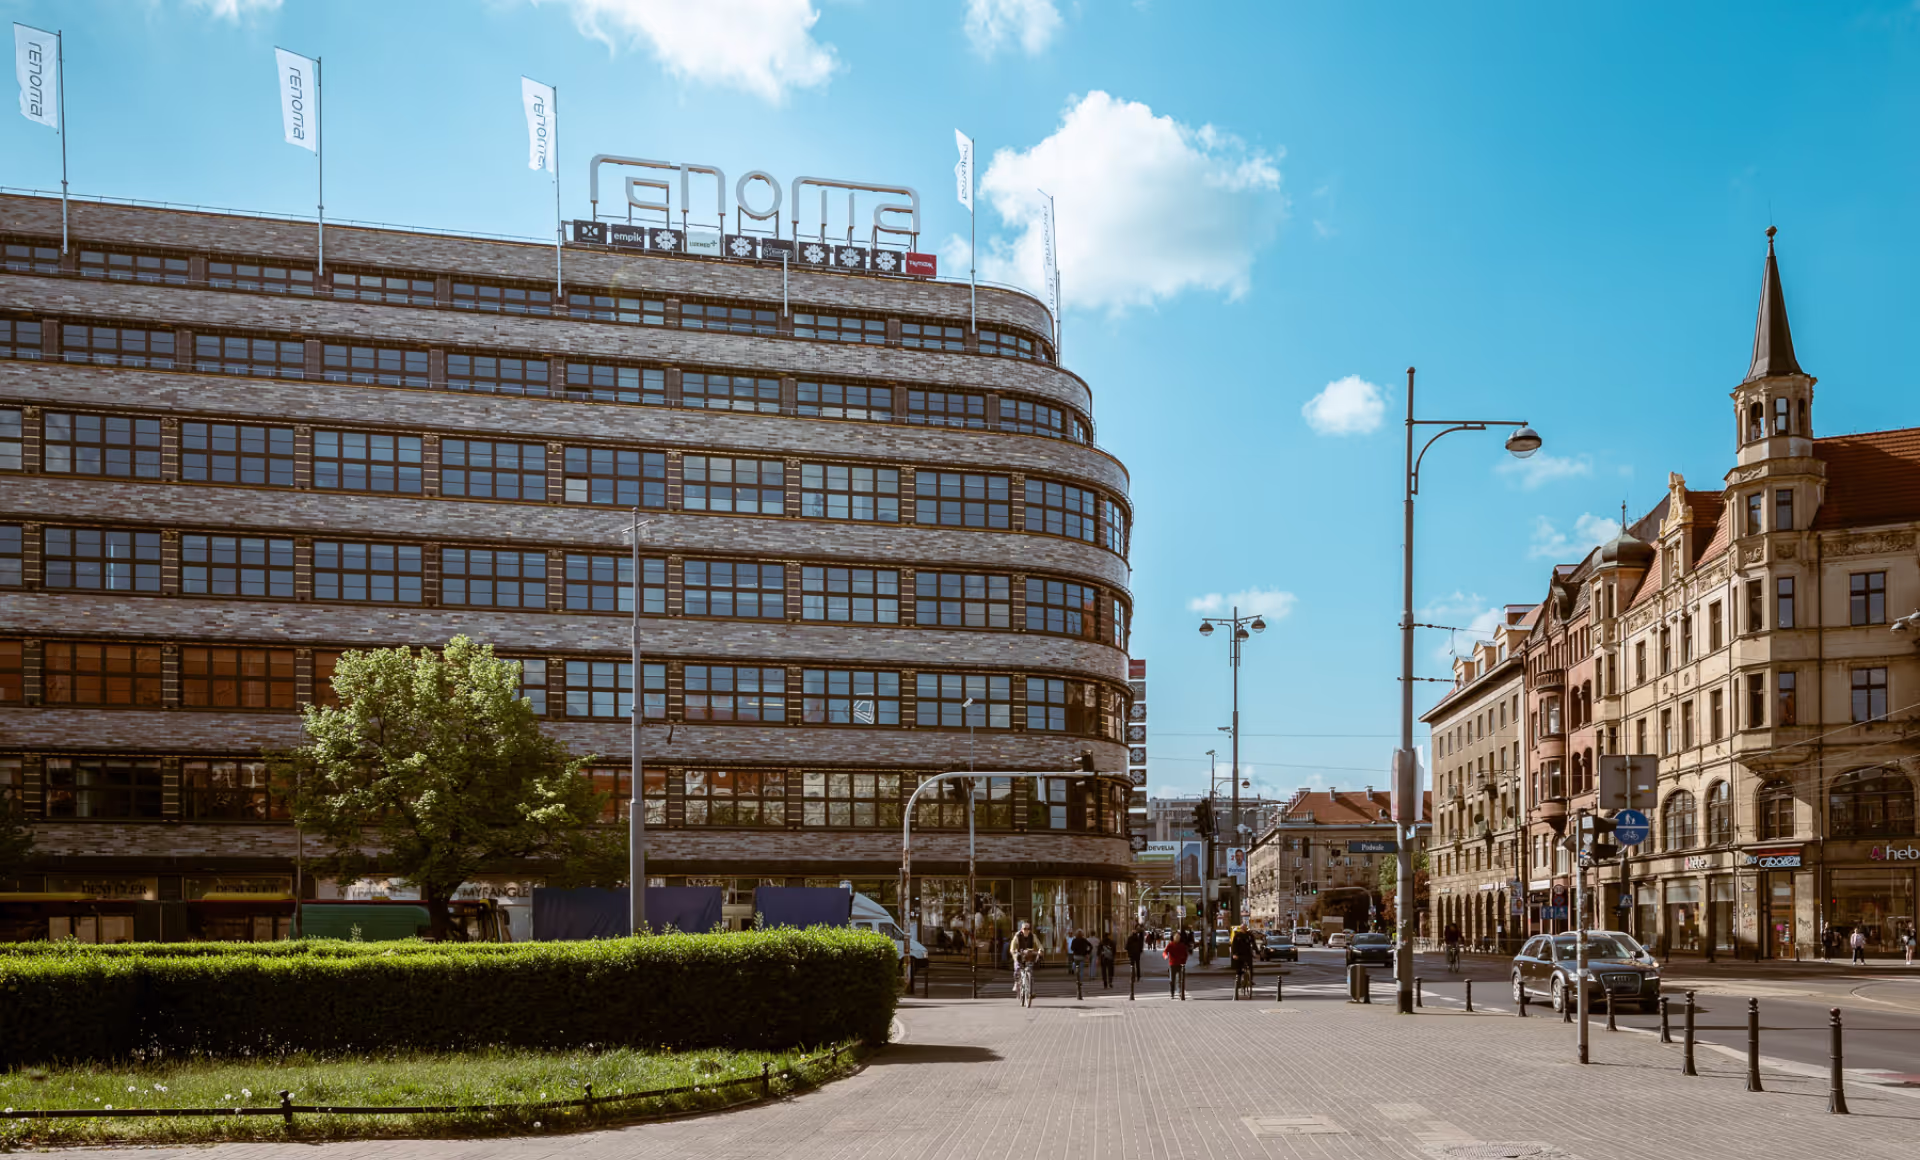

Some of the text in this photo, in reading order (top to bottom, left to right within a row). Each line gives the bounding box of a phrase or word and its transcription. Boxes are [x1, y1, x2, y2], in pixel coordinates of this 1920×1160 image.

[28, 41, 43, 117] renoma
[288, 66, 305, 141] renoma
[589, 153, 921, 236] renoma
[613, 231, 643, 243] empik
[1886, 845, 1920, 861] heb
